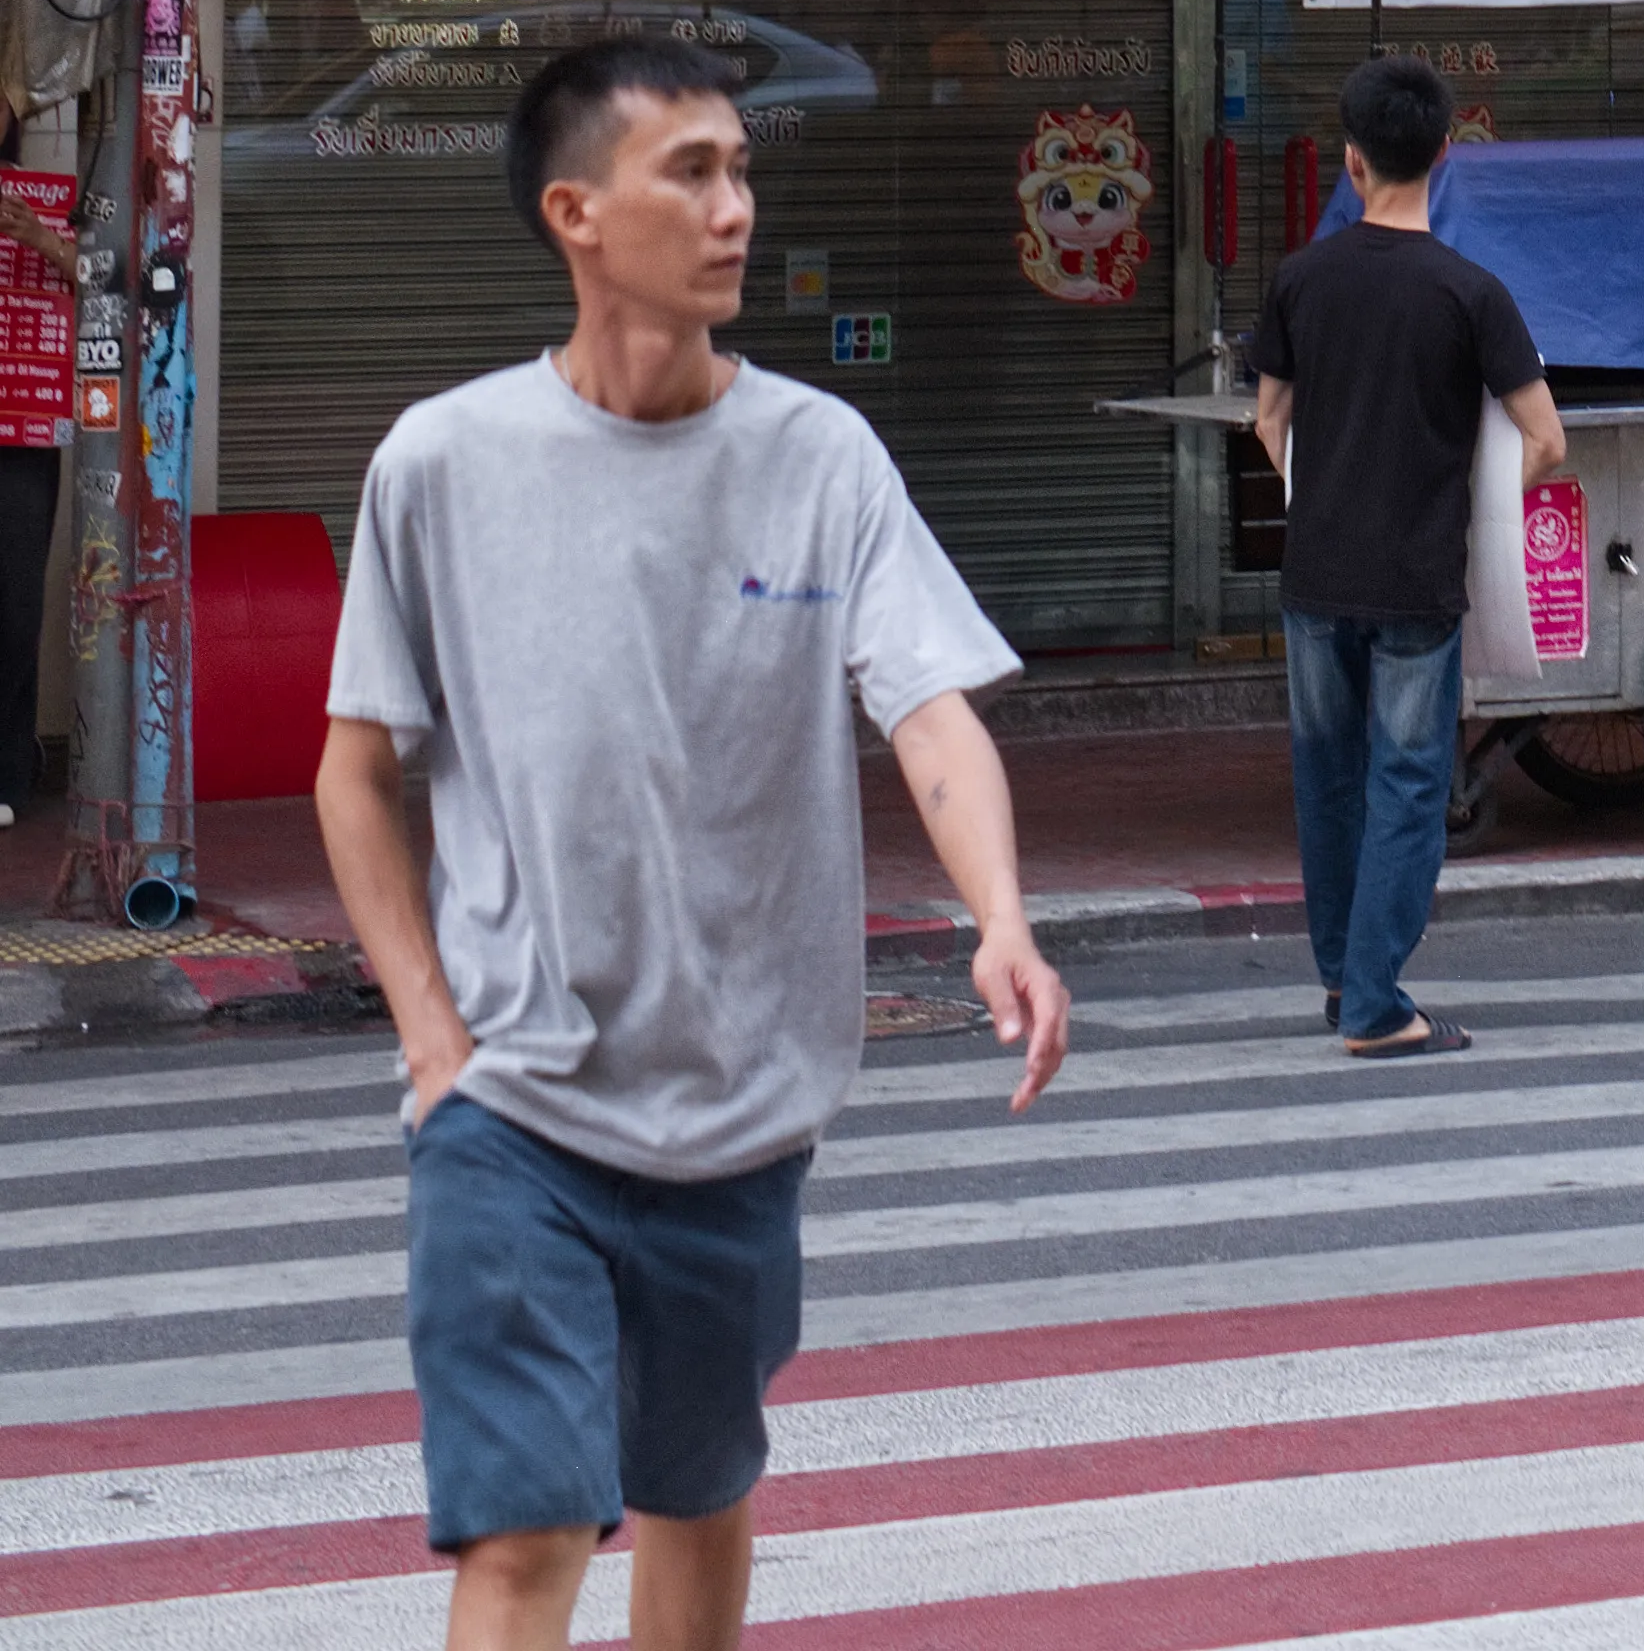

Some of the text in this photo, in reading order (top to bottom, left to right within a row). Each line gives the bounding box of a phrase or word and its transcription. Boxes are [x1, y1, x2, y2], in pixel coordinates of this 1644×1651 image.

[1006, 35, 1153, 78] ยินดีต้อนรับ
[0, 179, 70, 207] assage
[77, 339, 121, 361] BYO
